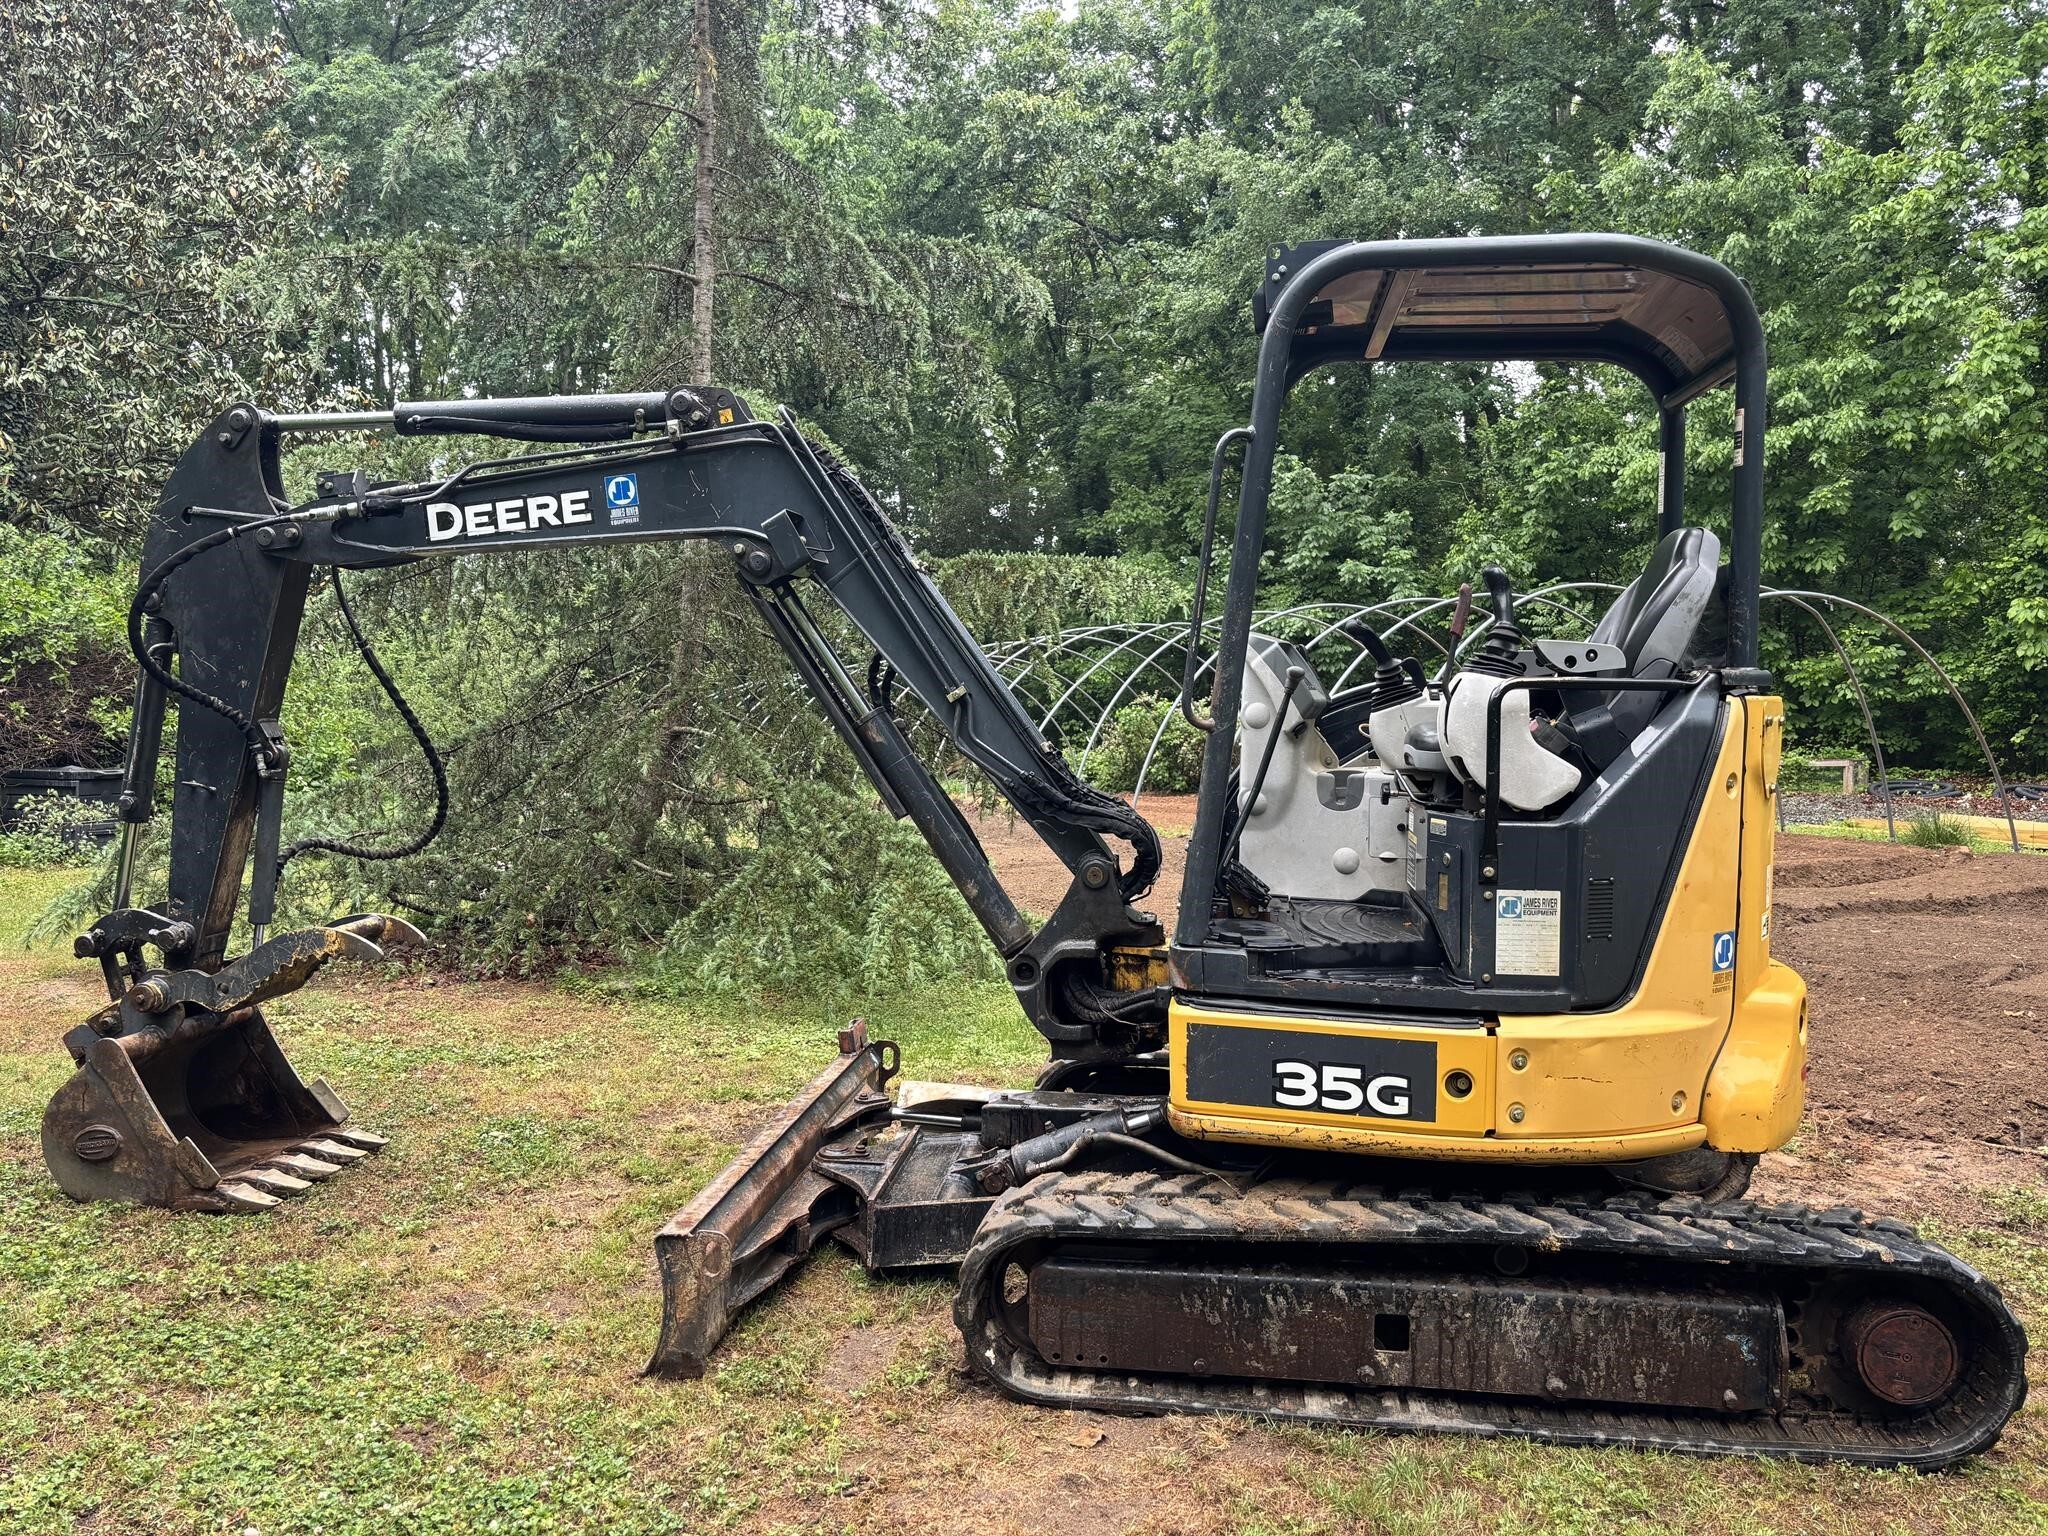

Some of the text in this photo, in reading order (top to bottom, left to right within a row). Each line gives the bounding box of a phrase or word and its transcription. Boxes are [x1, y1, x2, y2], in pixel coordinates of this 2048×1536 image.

[426, 490, 593, 542] DEERE
[1522, 909, 1558, 917] EQUIPMENT
[1523, 897, 1558, 909] JAMES RIVER
[1275, 1061, 1410, 1116] 35G
